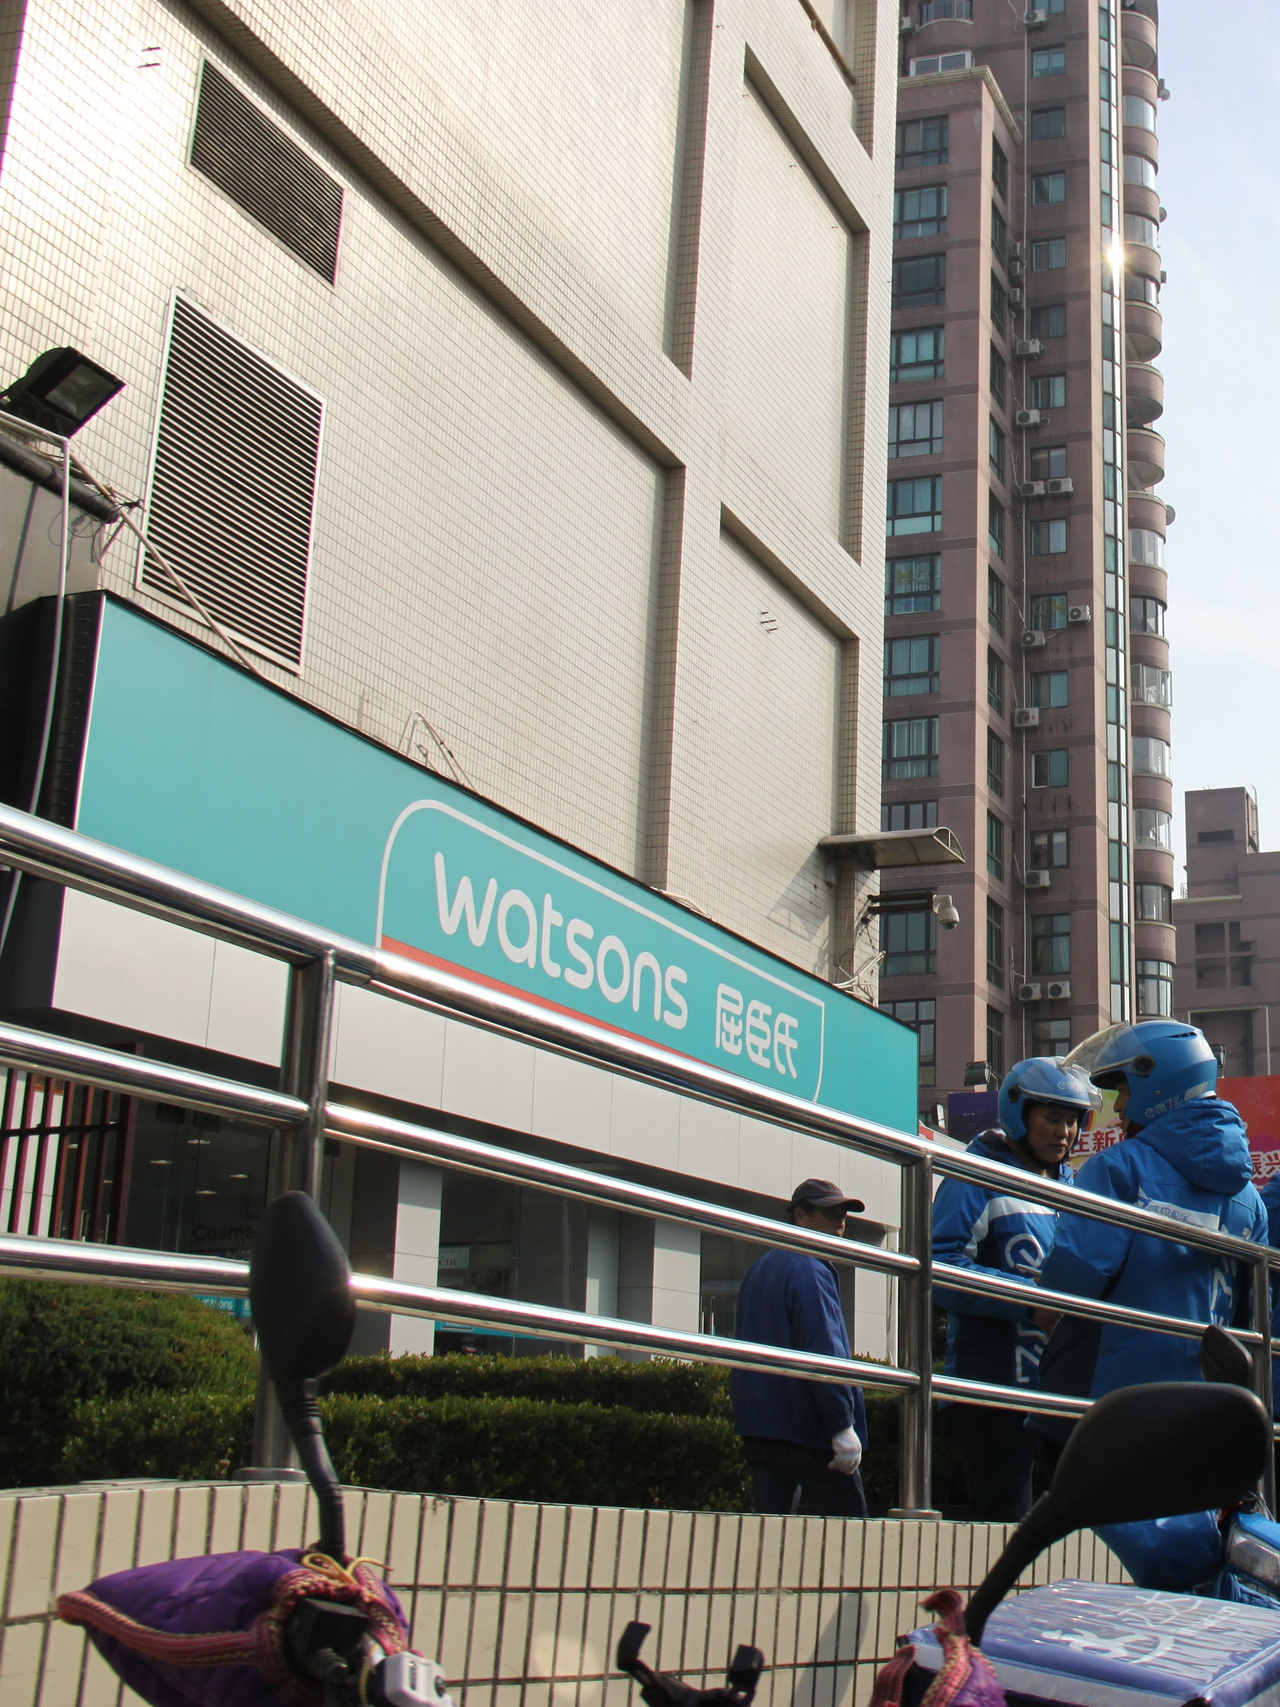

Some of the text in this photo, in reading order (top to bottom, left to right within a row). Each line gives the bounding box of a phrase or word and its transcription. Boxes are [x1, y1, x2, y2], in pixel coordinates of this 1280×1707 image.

[434, 851, 689, 1030] watsons
[715, 982, 800, 1079] 屈臣氏
